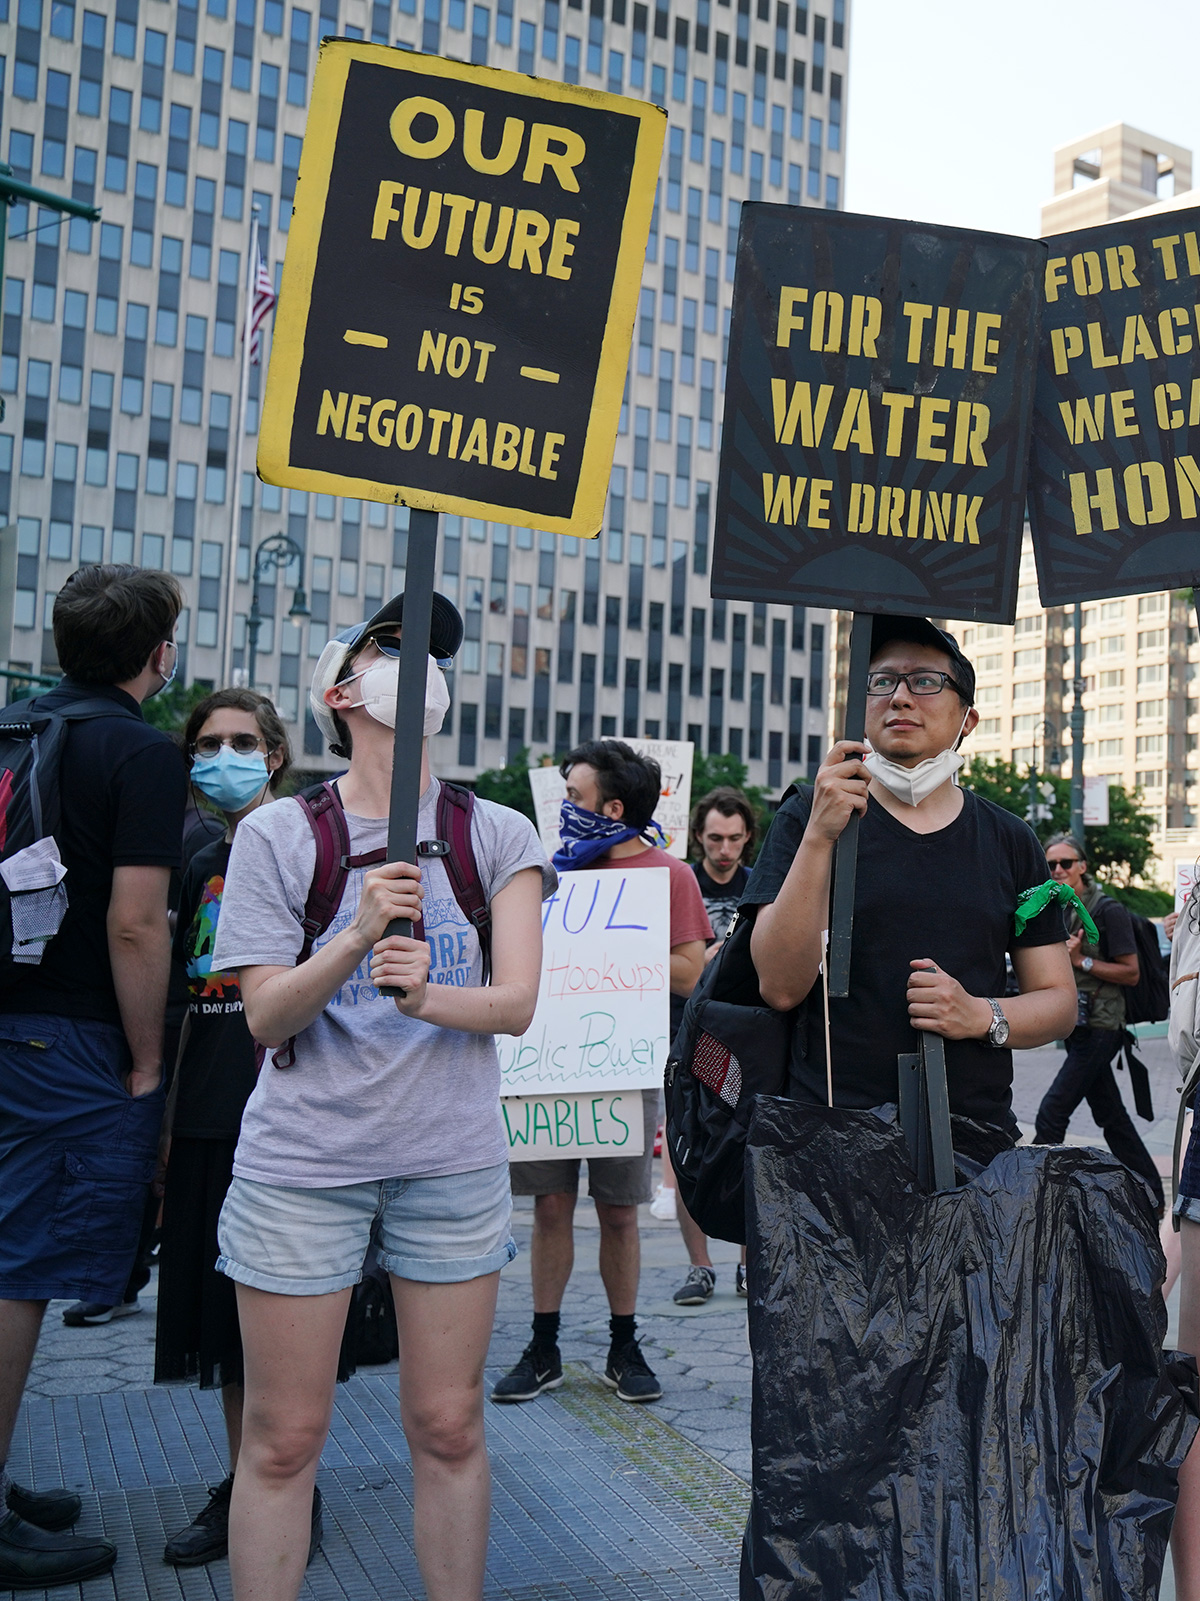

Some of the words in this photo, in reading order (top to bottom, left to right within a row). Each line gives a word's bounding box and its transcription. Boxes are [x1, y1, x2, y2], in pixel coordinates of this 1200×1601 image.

[390, 96, 585, 193] OUR
[371, 181, 580, 280] FUTURE
[450, 283, 484, 314] IS
[1045, 245, 1140, 302] FOR
[418, 330, 496, 382] NOT
[777, 286, 882, 358] FOR
[903, 302, 1001, 374] THE
[317, 390, 565, 480] NEGOTIABLE
[771, 379, 990, 466] WATER
[1059, 390, 1139, 444] WE
[763, 473, 833, 529] WE
[848, 483, 983, 544] DRINK
[202, 1002, 224, 1014] DAY
[578, 1011, 667, 1073] Power
[502, 1097, 629, 1147] WABLES
